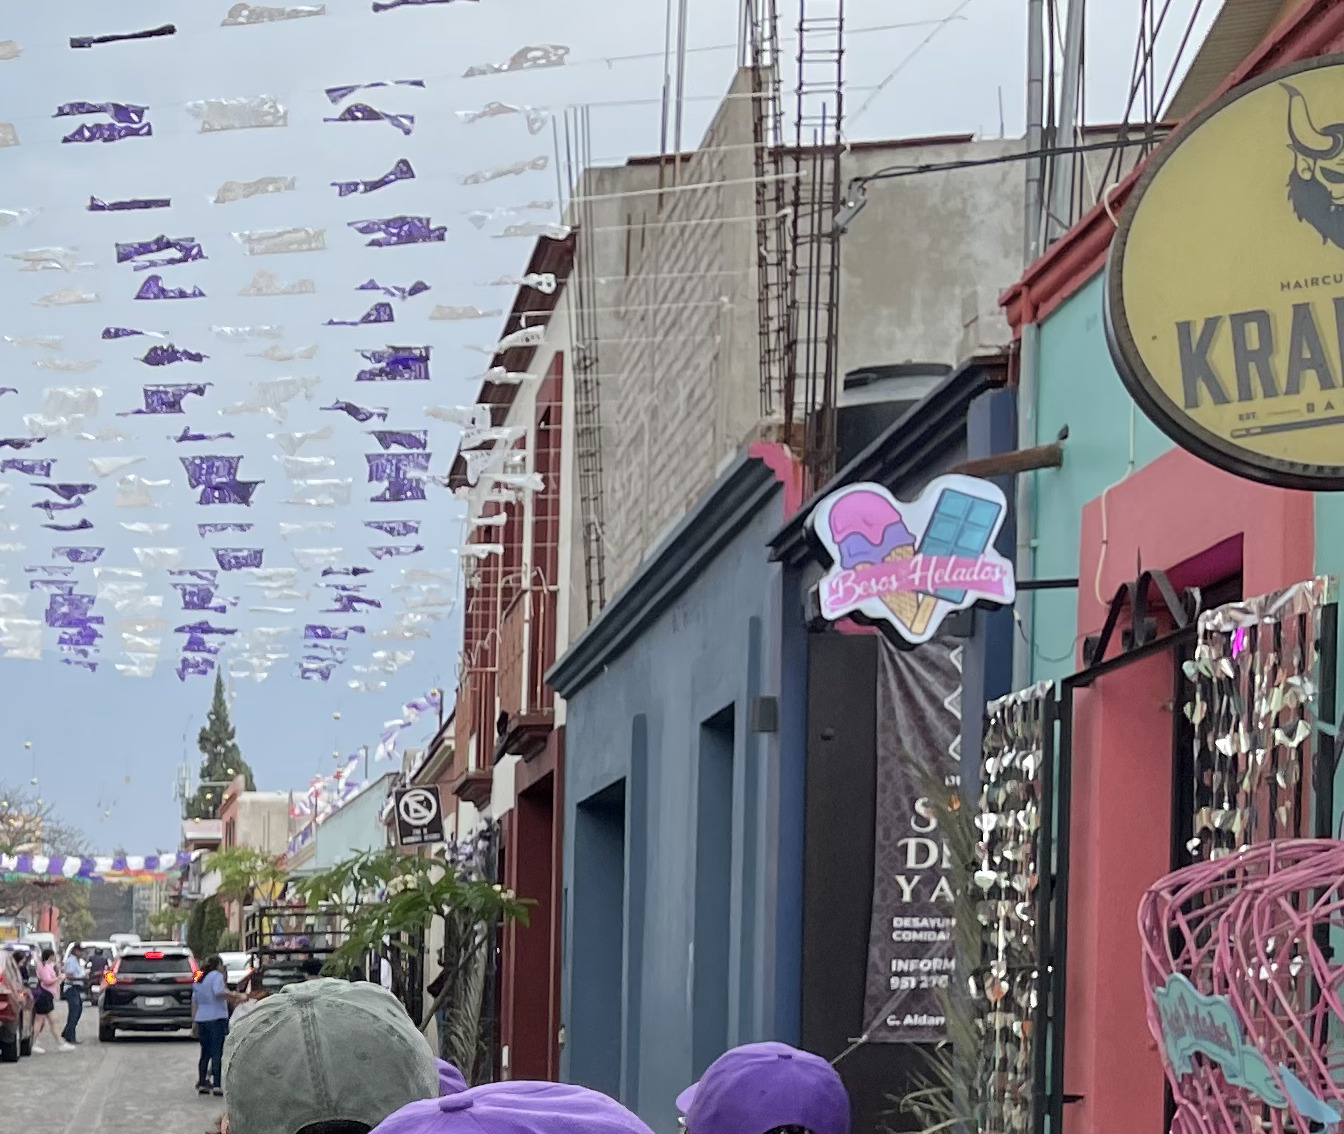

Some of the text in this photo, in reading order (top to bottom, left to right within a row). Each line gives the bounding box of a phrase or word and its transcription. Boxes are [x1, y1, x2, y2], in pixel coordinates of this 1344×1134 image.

[1175, 296, 1344, 410] KRA
[826, 553, 1007, 608] Besos Helados
